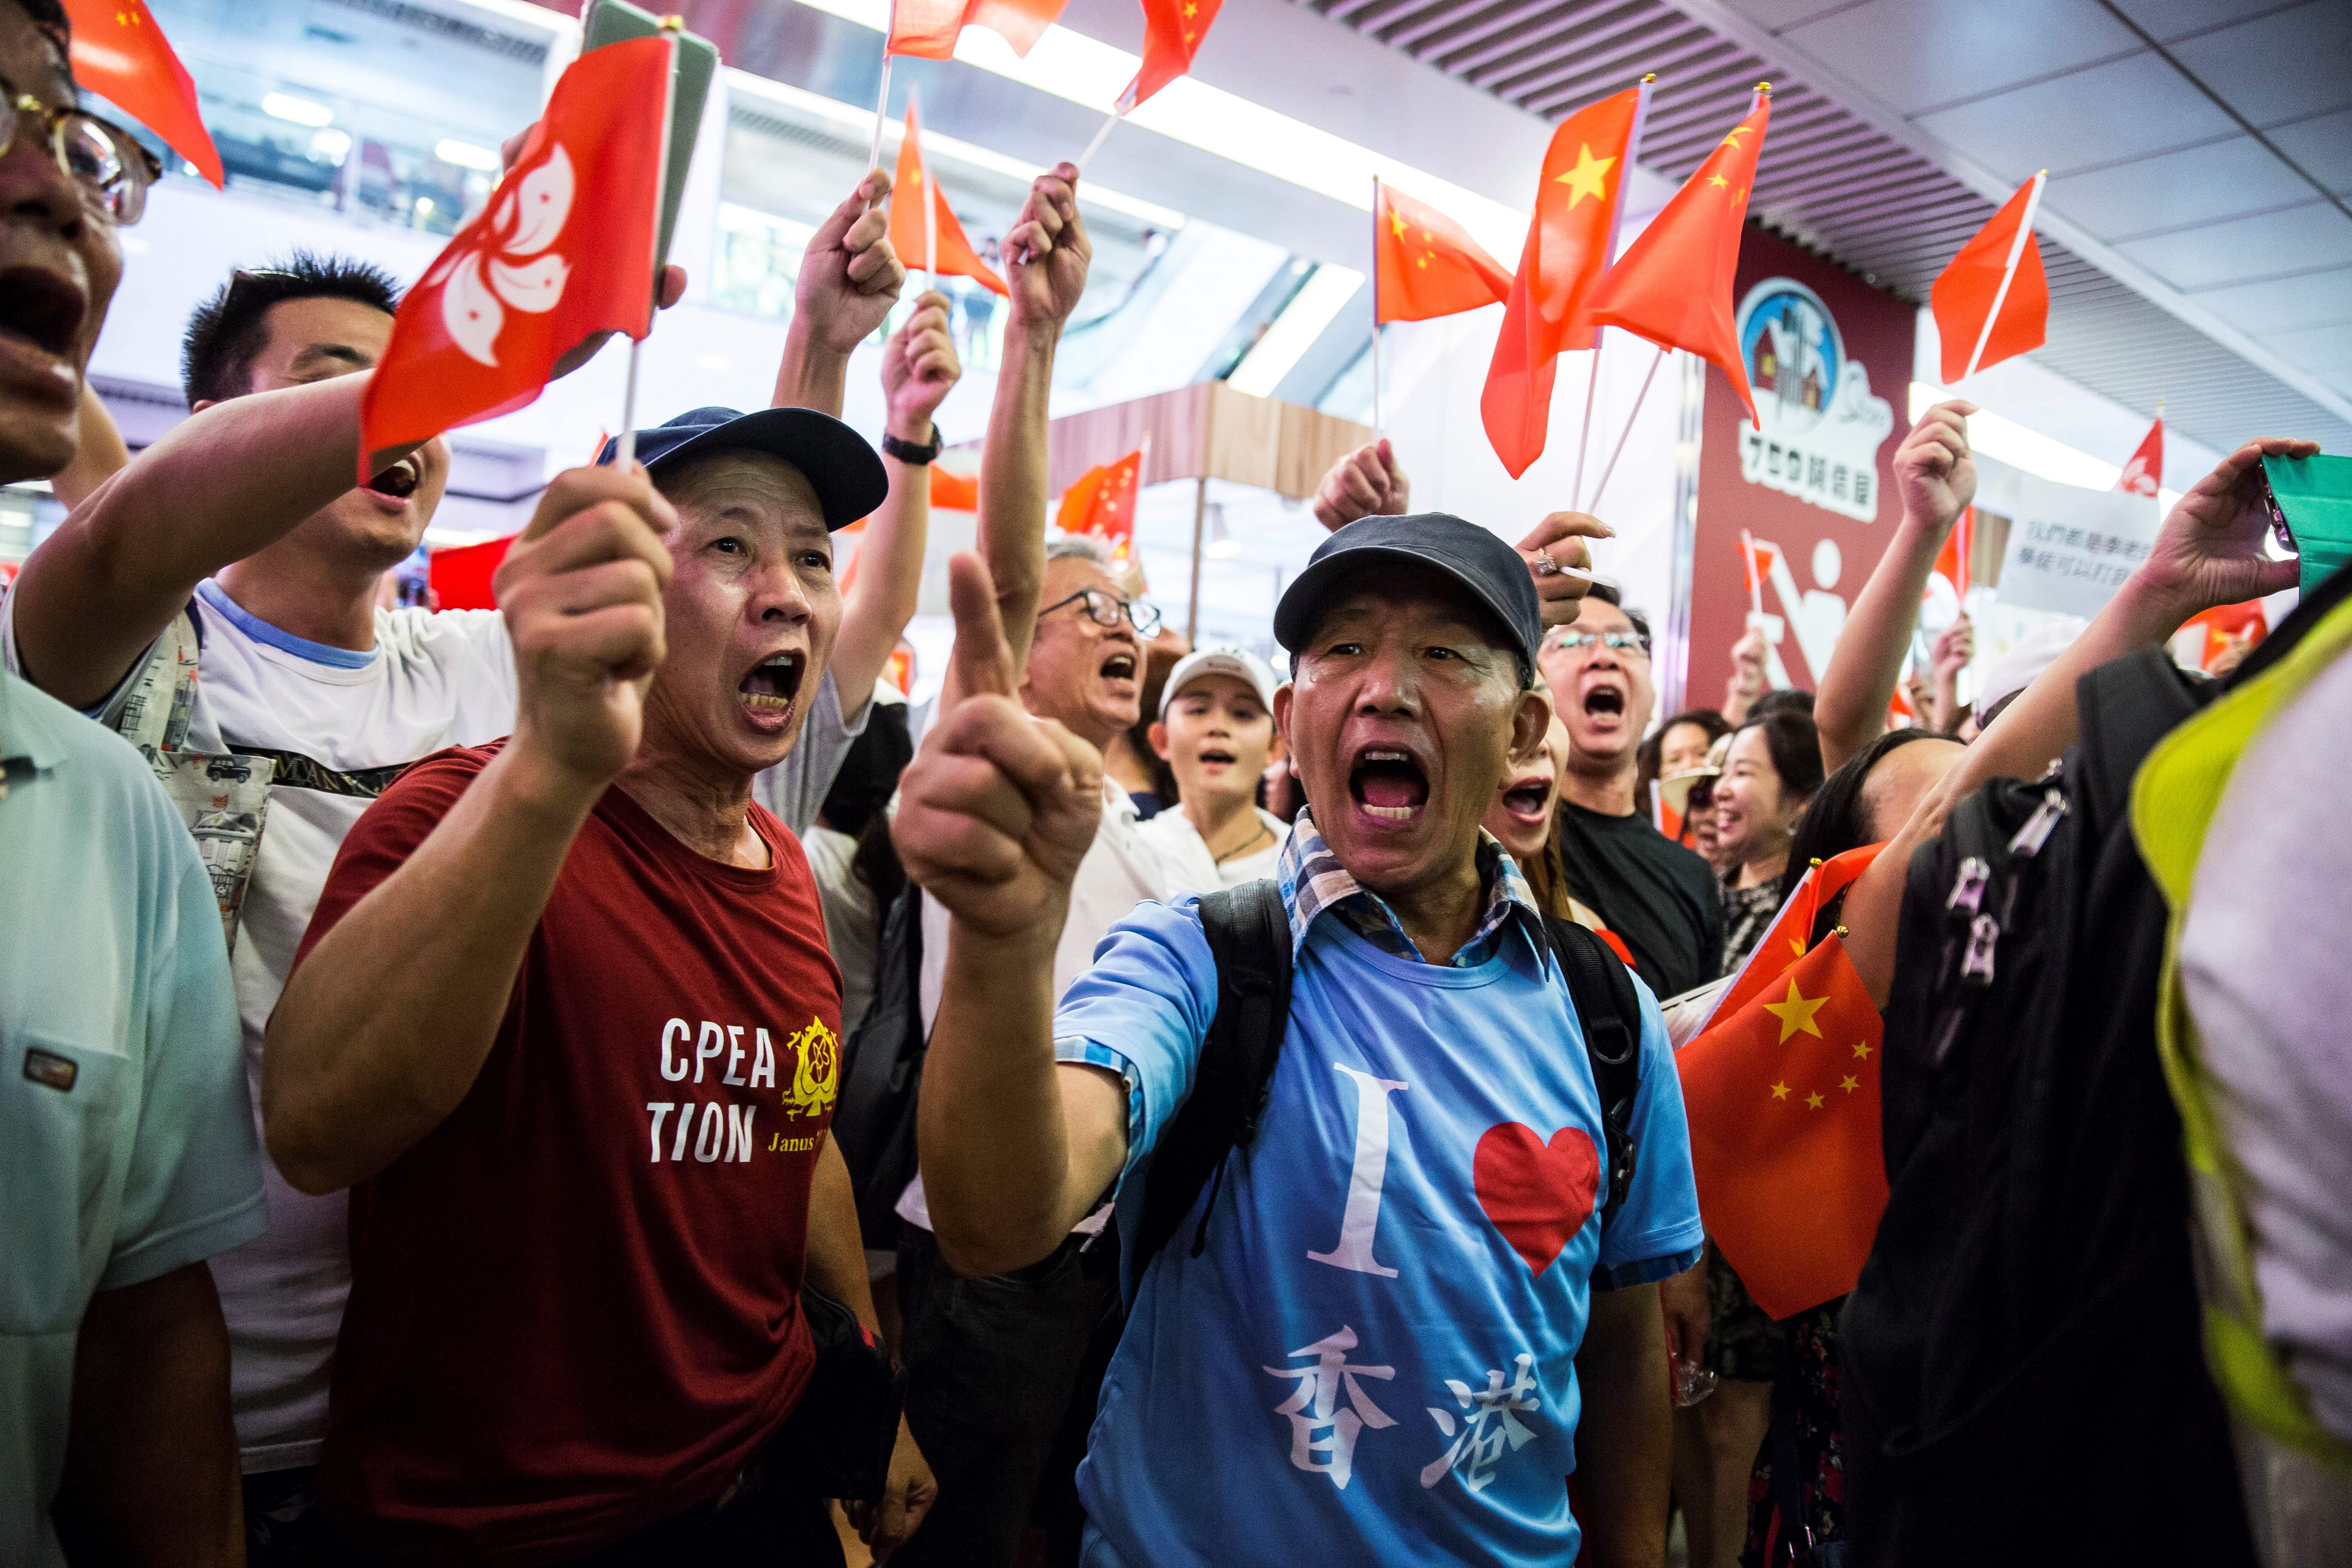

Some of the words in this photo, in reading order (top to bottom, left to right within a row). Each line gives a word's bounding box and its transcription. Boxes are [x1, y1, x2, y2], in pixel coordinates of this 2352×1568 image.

[646, 1102, 757, 1163] TION
[768, 1132, 814, 1152] Janus
[1307, 1060, 1410, 1279] I
[1263, 1324, 1541, 1492] 香港
